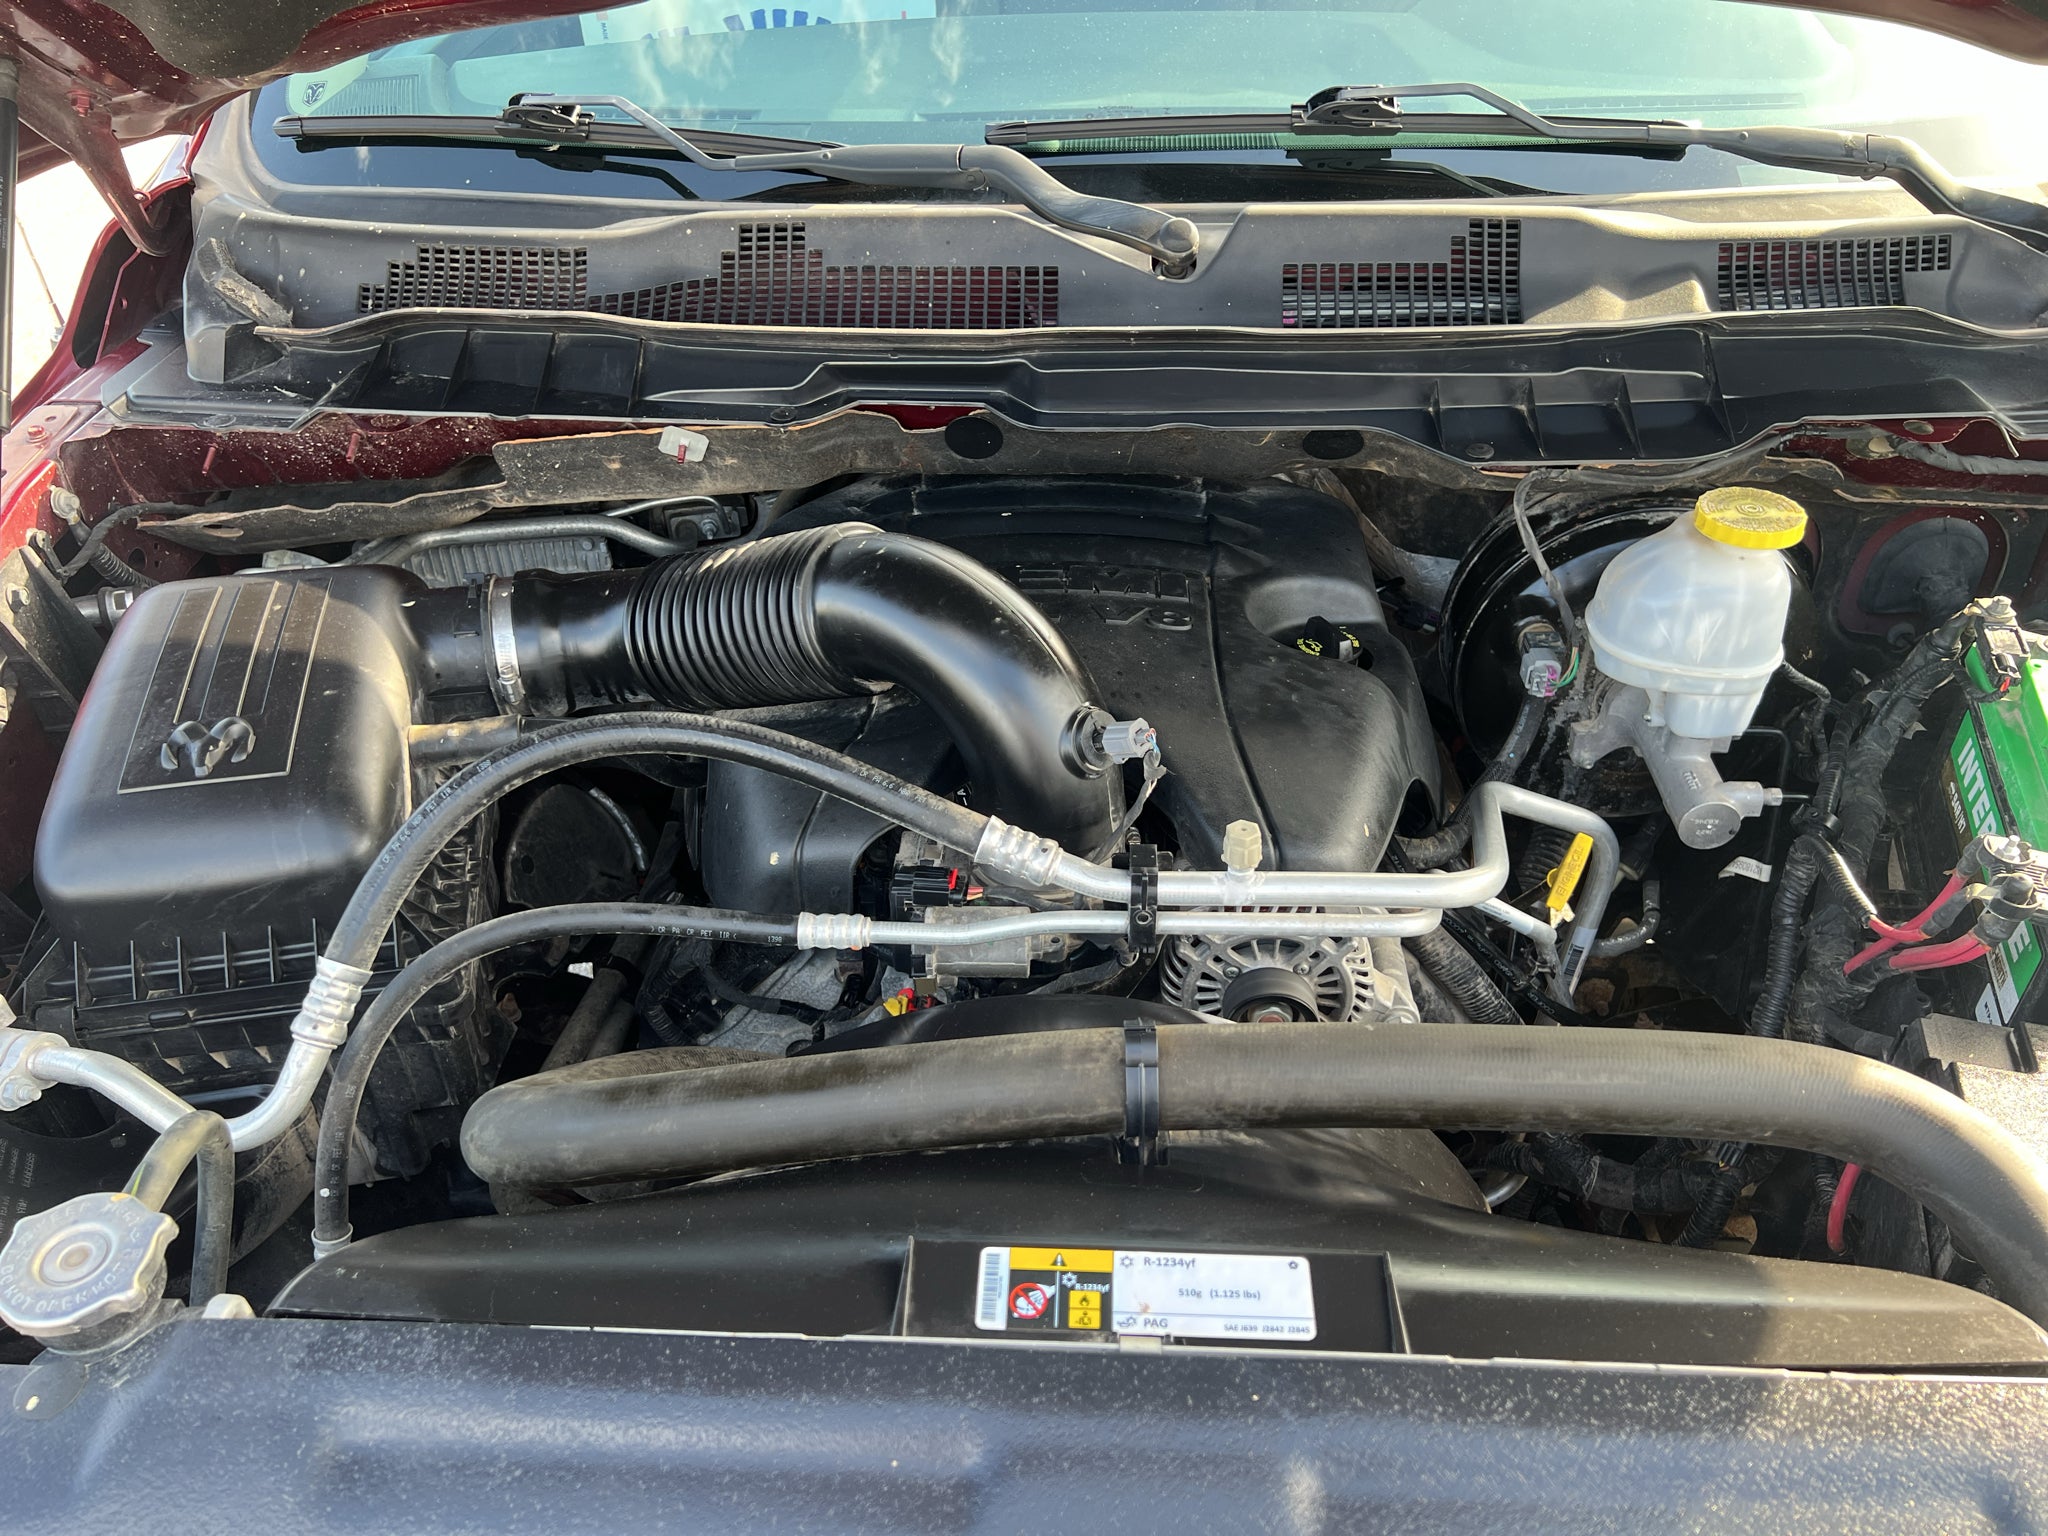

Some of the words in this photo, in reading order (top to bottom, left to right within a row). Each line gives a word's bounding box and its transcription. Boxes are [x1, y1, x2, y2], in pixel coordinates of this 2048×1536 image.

[1143, 1256, 1196, 1269] R-1234yf
[1178, 1288, 1202, 1299] 510g
[1209, 1288, 1241, 1299] (1.125
[1242, 1290, 1261, 1300] lbs)
[1143, 1317, 1168, 1328] PAG
